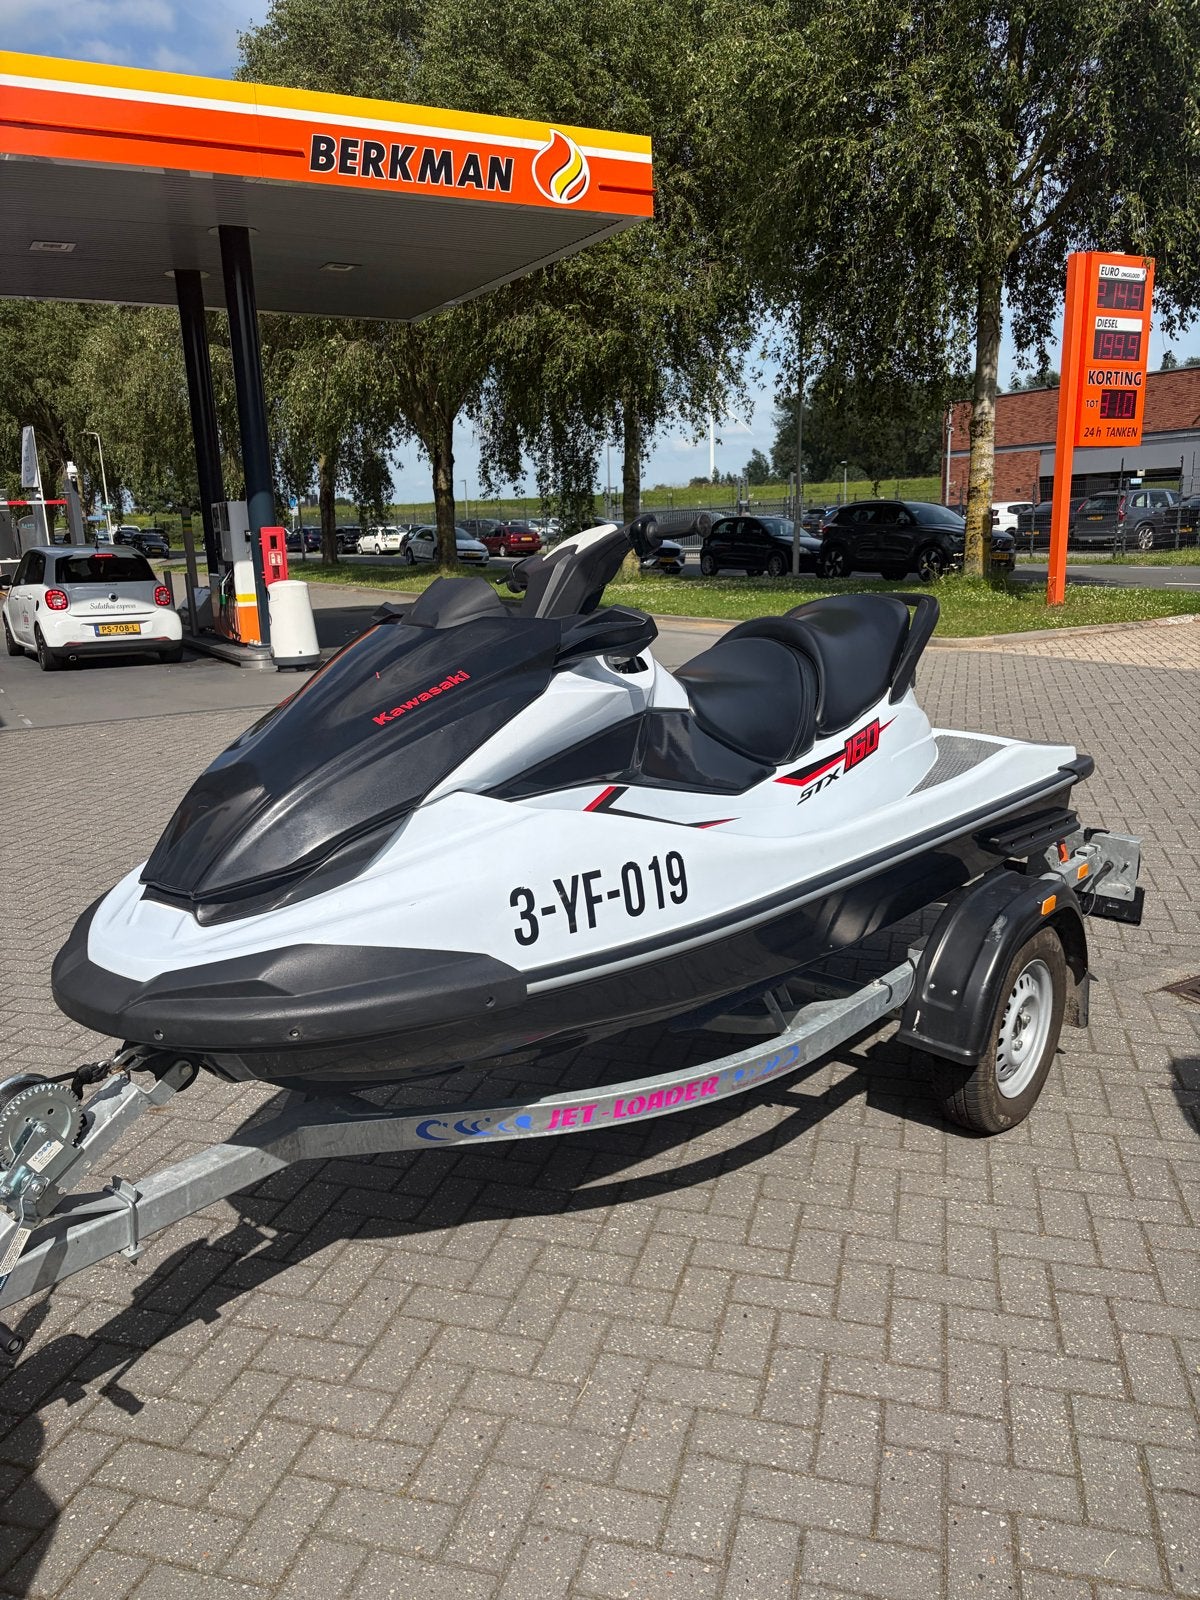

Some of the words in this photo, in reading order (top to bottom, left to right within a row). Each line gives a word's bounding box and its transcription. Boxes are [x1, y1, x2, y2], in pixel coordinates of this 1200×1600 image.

[309, 134, 514, 193] BERKMAN
[1101, 266, 1119, 277] EURO
[1097, 318, 1118, 328] DIESEL
[1098, 333, 1139, 359] 199.9
[1088, 370, 1142, 386] KORTING
[1086, 400, 1098, 408] TOT
[1106, 427, 1137, 437] TANKEN
[372, 670, 471, 726] Kawasaki
[796, 766, 841, 806] STX
[843, 717, 880, 774] 160
[509, 851, 688, 946] 3-YF-019
